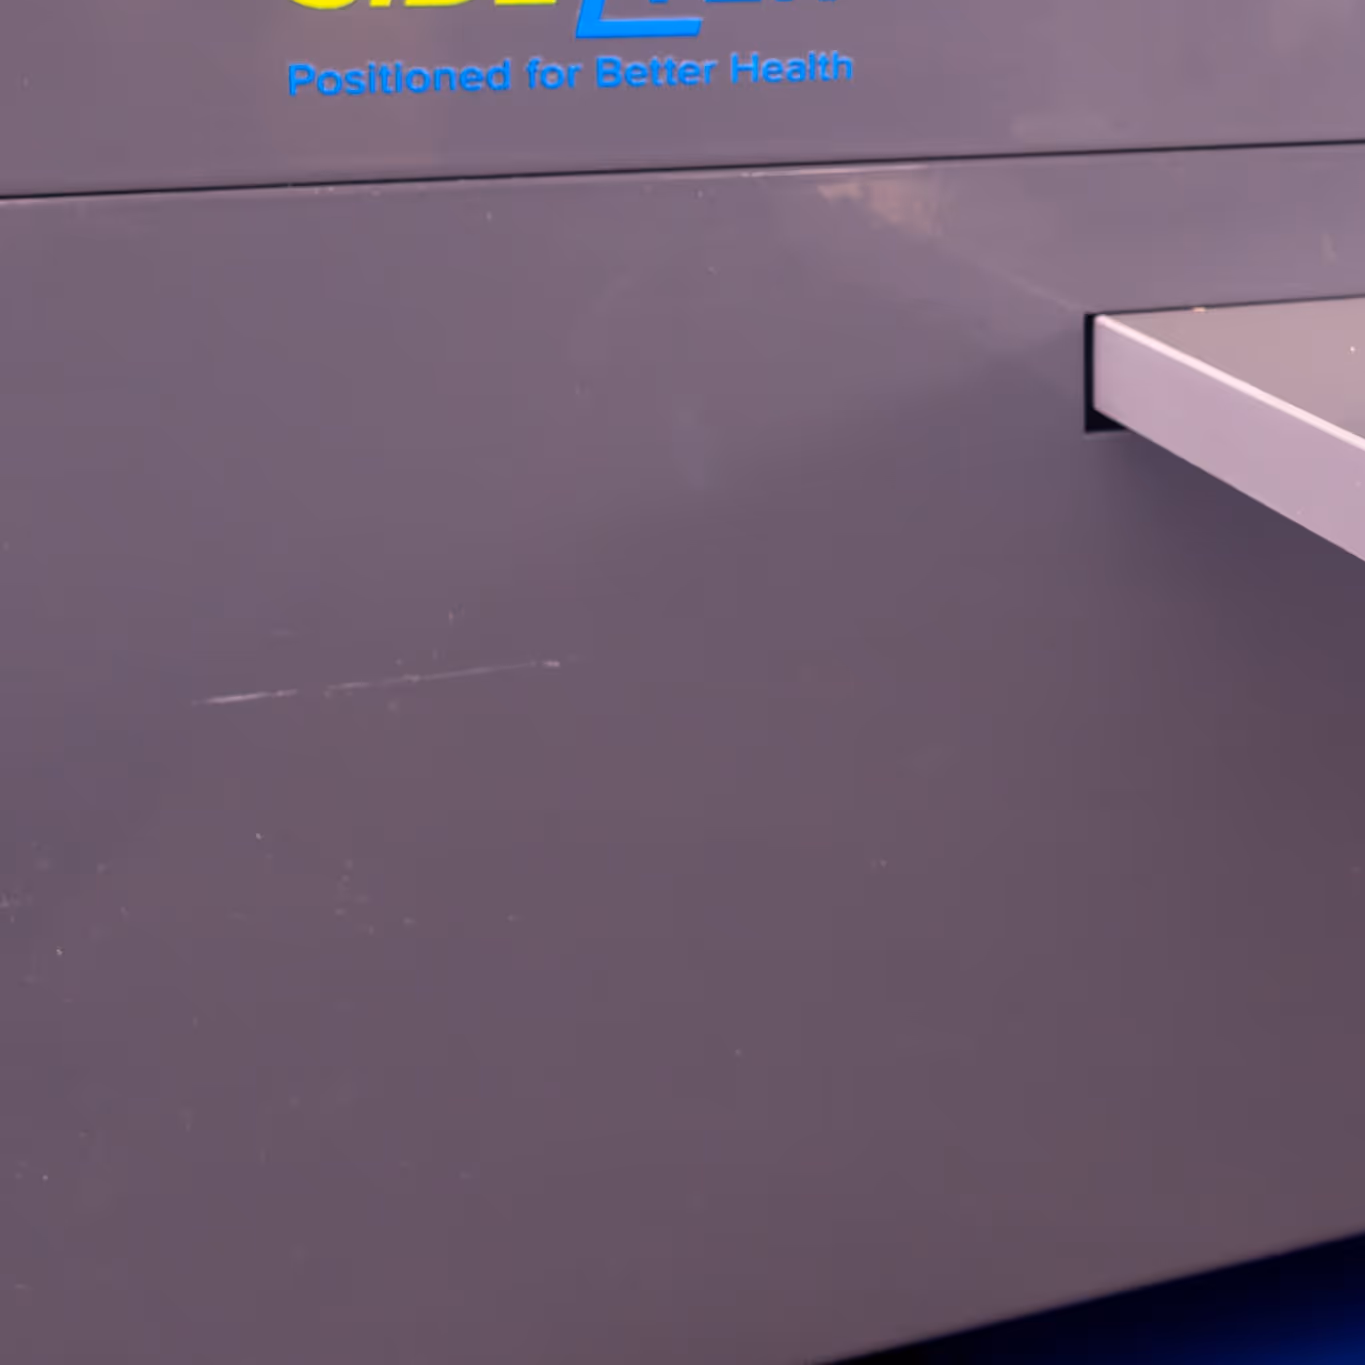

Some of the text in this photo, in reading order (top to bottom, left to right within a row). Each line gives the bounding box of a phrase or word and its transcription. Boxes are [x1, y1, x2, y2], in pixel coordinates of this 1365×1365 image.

[288, 47, 854, 96] Positioned for Better Health
